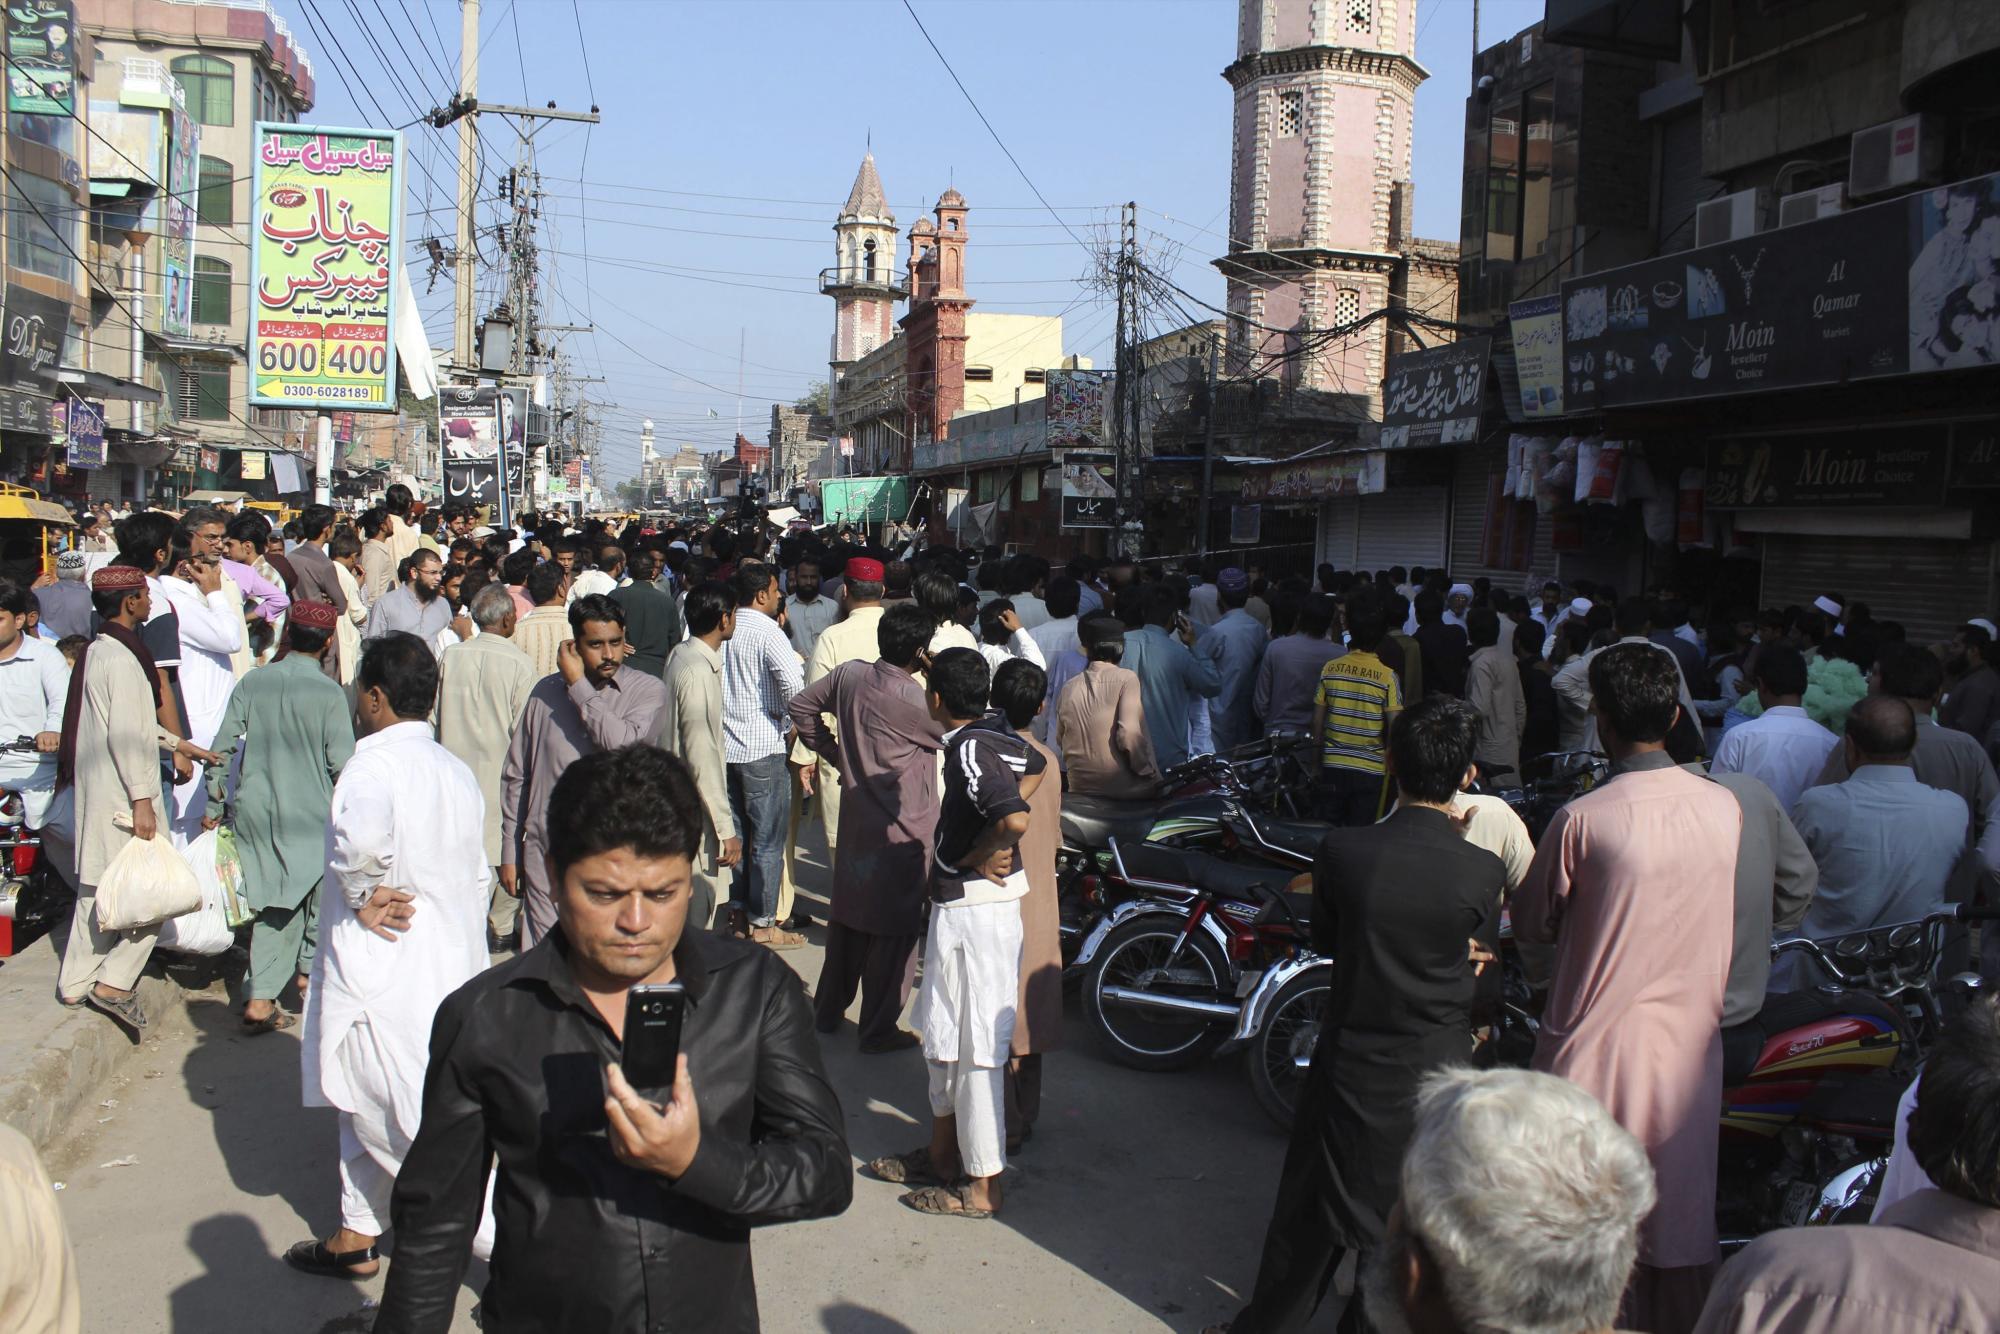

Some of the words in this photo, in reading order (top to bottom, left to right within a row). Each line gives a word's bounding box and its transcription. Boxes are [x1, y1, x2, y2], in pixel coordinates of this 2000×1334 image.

[262, 135, 300, 164] سیل
[301, 134, 357, 172] سیل
[262, 187, 389, 261] چناب
[1827, 259, 1846, 283] Al
[1811, 293, 1861, 319] Qamar
[1724, 320, 1776, 352] Moin
[1822, 326, 1850, 339] Market
[259, 341, 317, 372] 600
[328, 344, 386, 375] 400
[1730, 351, 1769, 366] Jewellery
[1735, 367, 1764, 380] Choice
[284, 385, 369, 398] 0300-6028189
[1796, 448, 1867, 486] Moin
[449, 468, 493, 498] میاں
[1077, 497, 1101, 514] میاں
